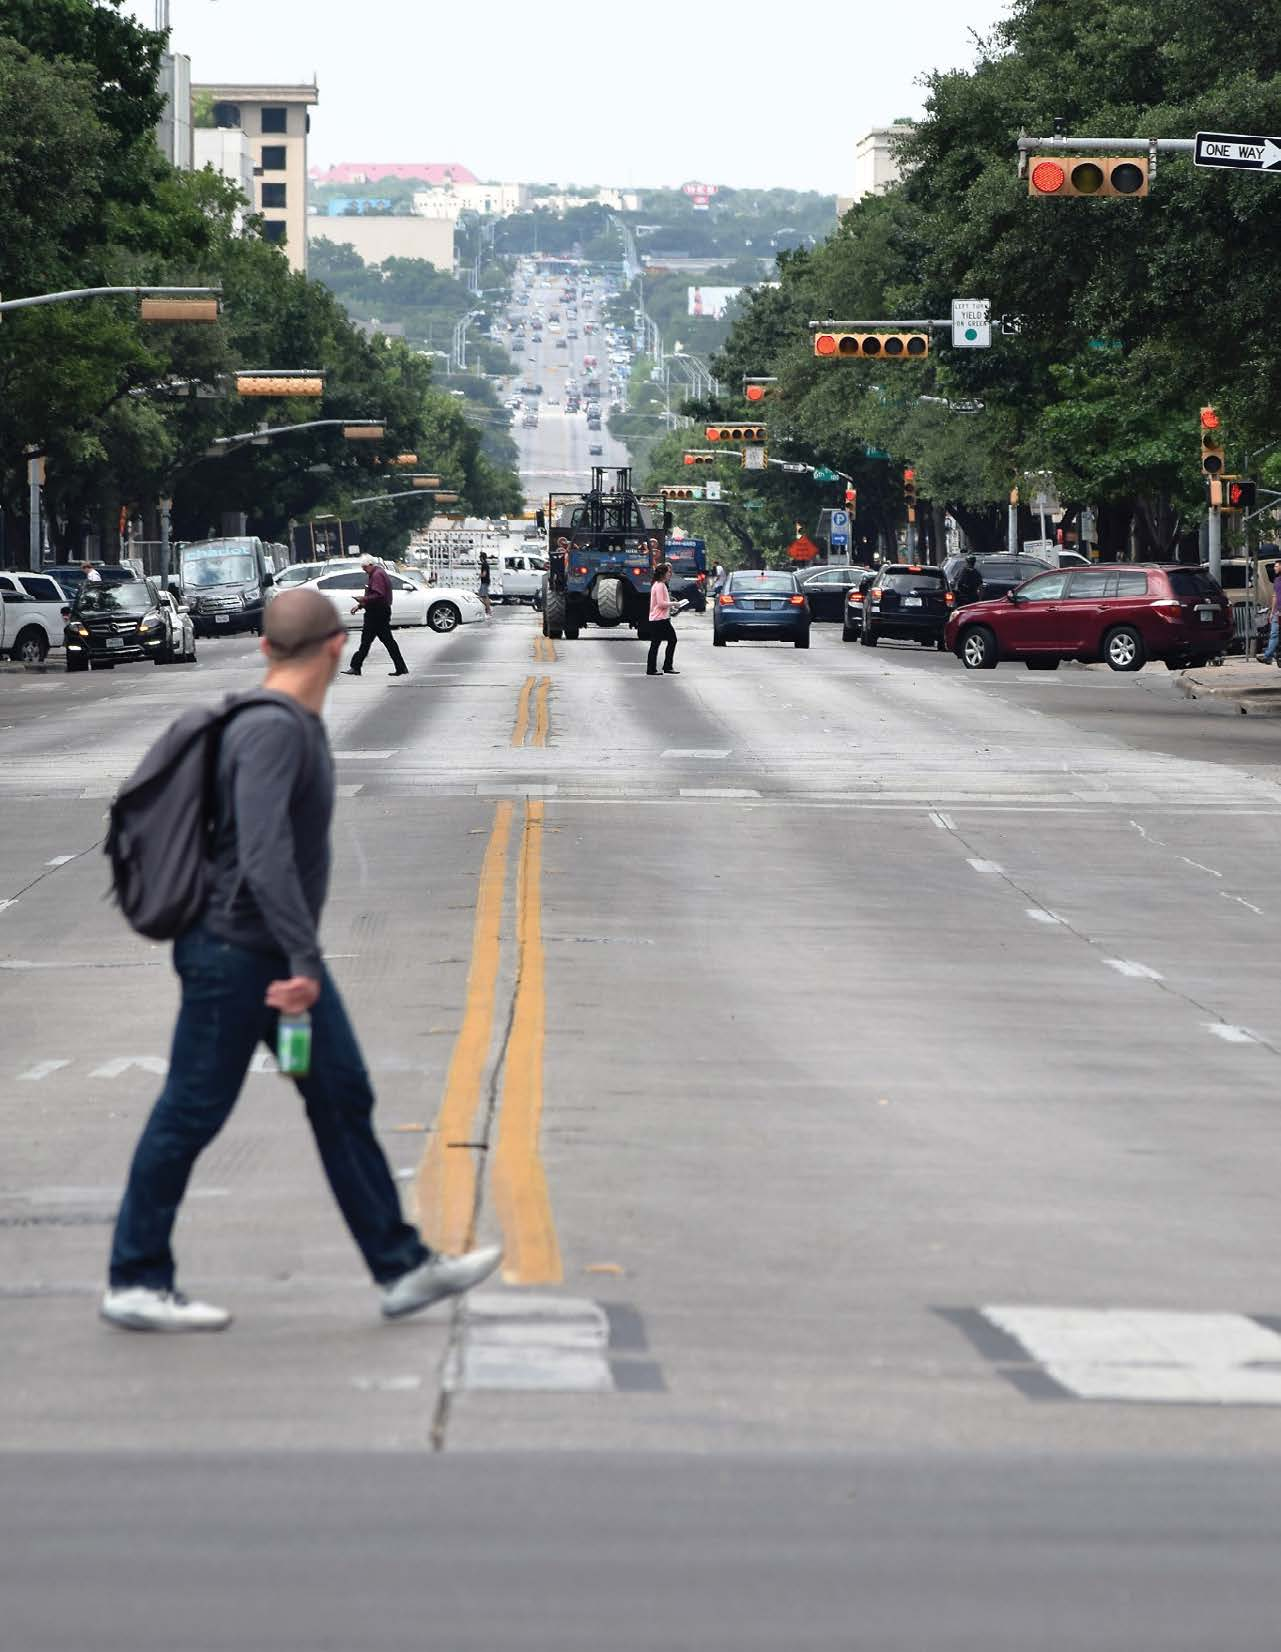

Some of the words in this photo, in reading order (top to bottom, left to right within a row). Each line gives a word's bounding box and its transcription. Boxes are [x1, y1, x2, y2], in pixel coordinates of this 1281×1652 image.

[1206, 144, 1231, 157] ONE
[1239, 146, 1265, 159] WAY
[961, 311, 983, 320] YIELD
